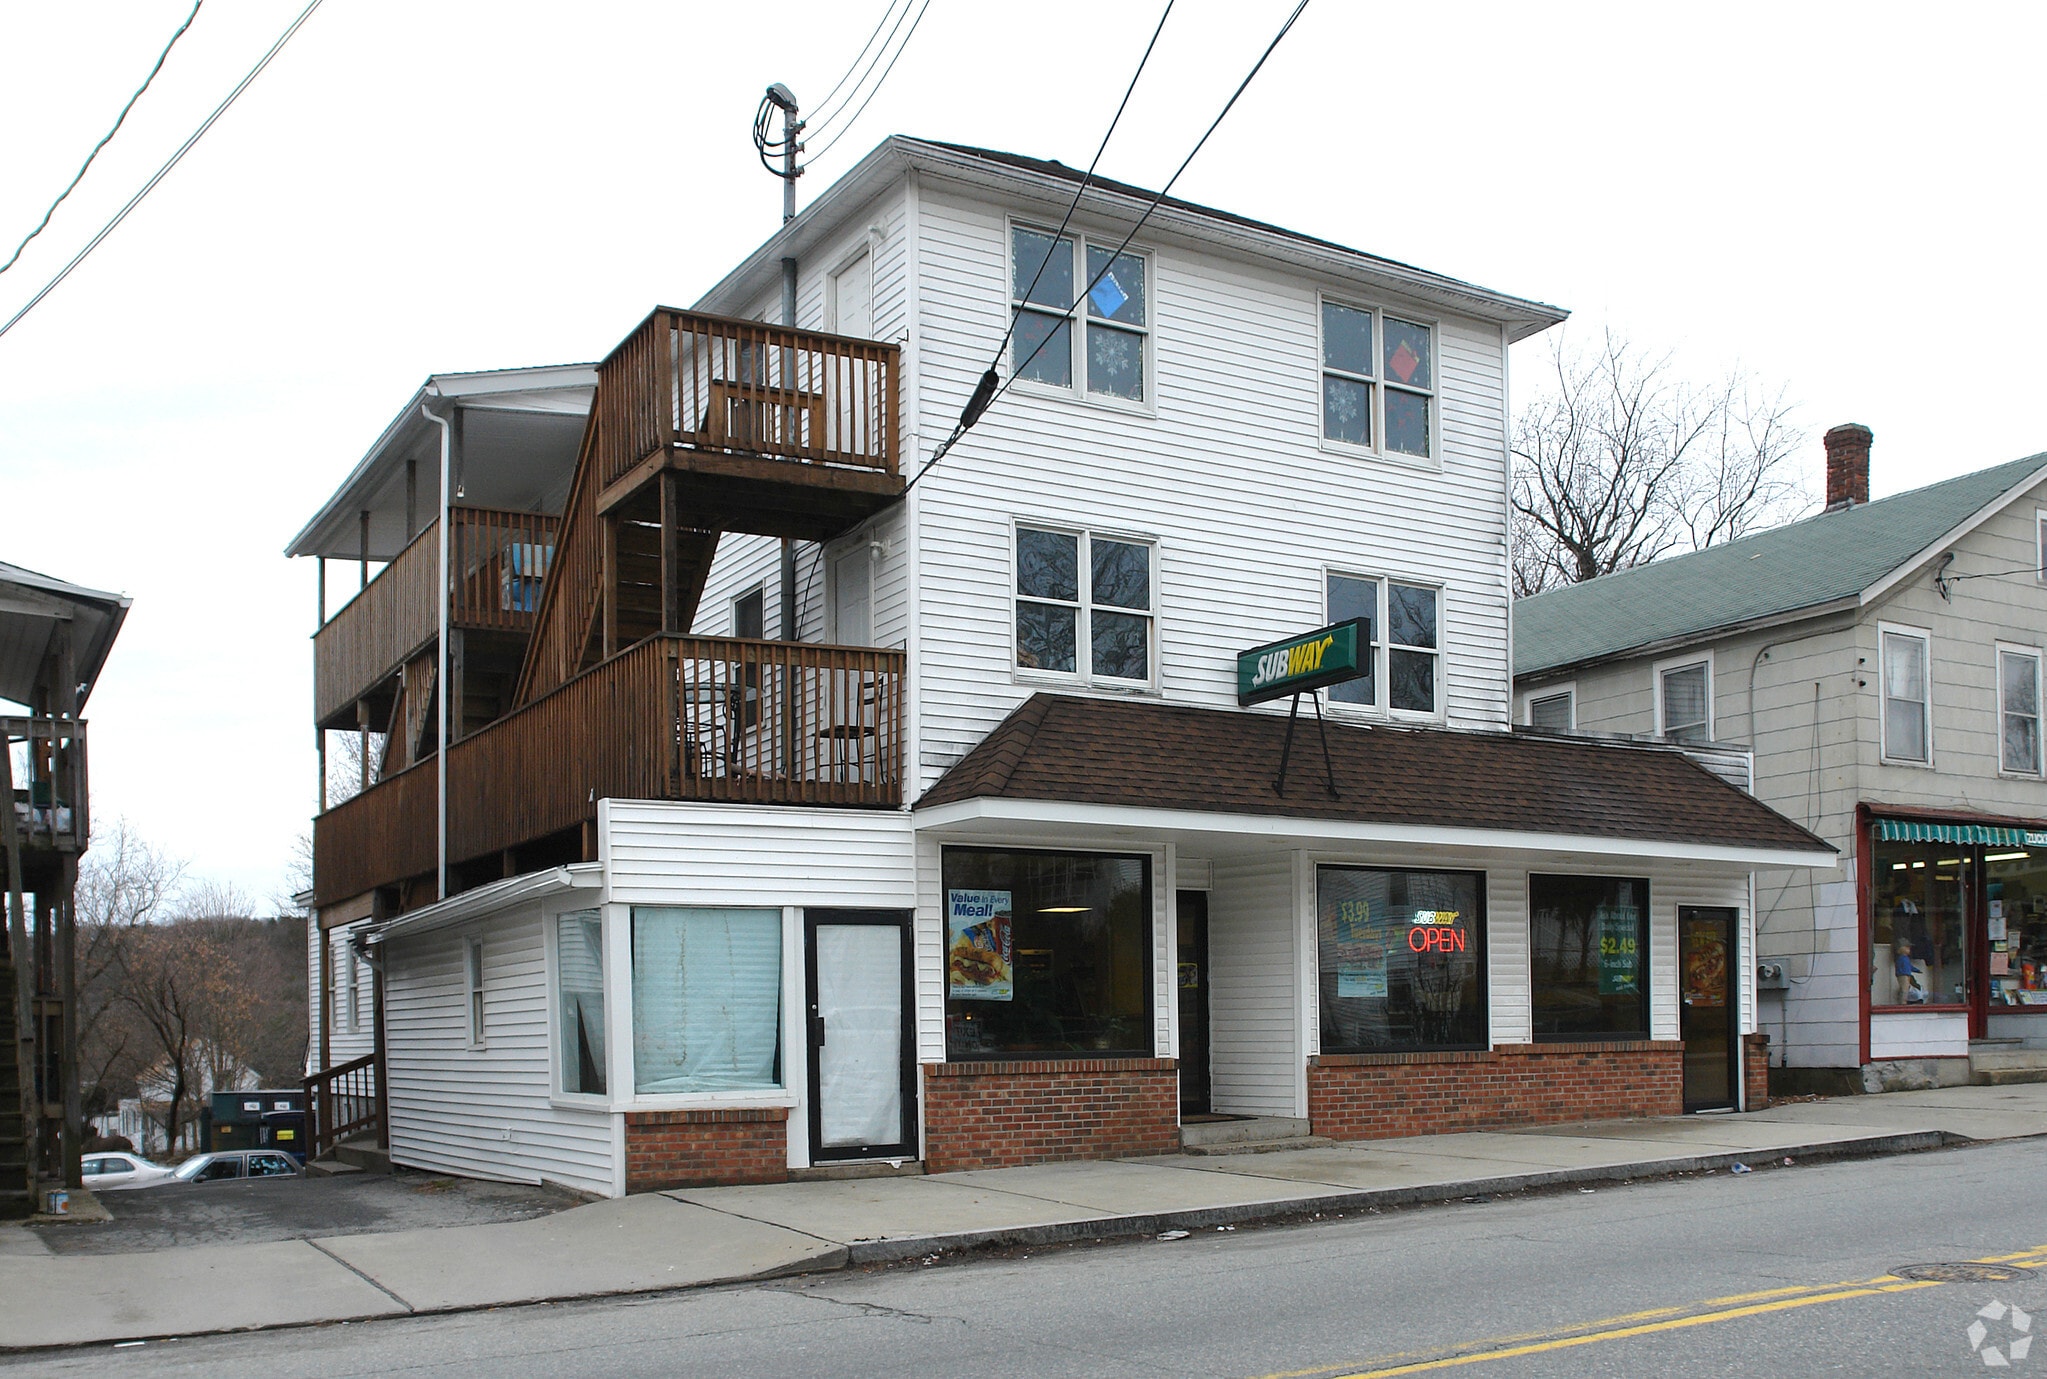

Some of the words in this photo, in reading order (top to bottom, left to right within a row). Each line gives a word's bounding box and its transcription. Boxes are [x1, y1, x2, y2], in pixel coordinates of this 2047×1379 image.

[1251, 633, 1335, 688] SUBWAY
[951, 893, 980, 903] Value
[990, 895, 1009, 905] Every
[954, 904, 993, 917] Meal!
[1341, 901, 1370, 922] $3.99
[1412, 910, 1460, 925] SUBWAY
[1408, 927, 1465, 952] OPEN
[1600, 937, 1635, 955] $2.49
